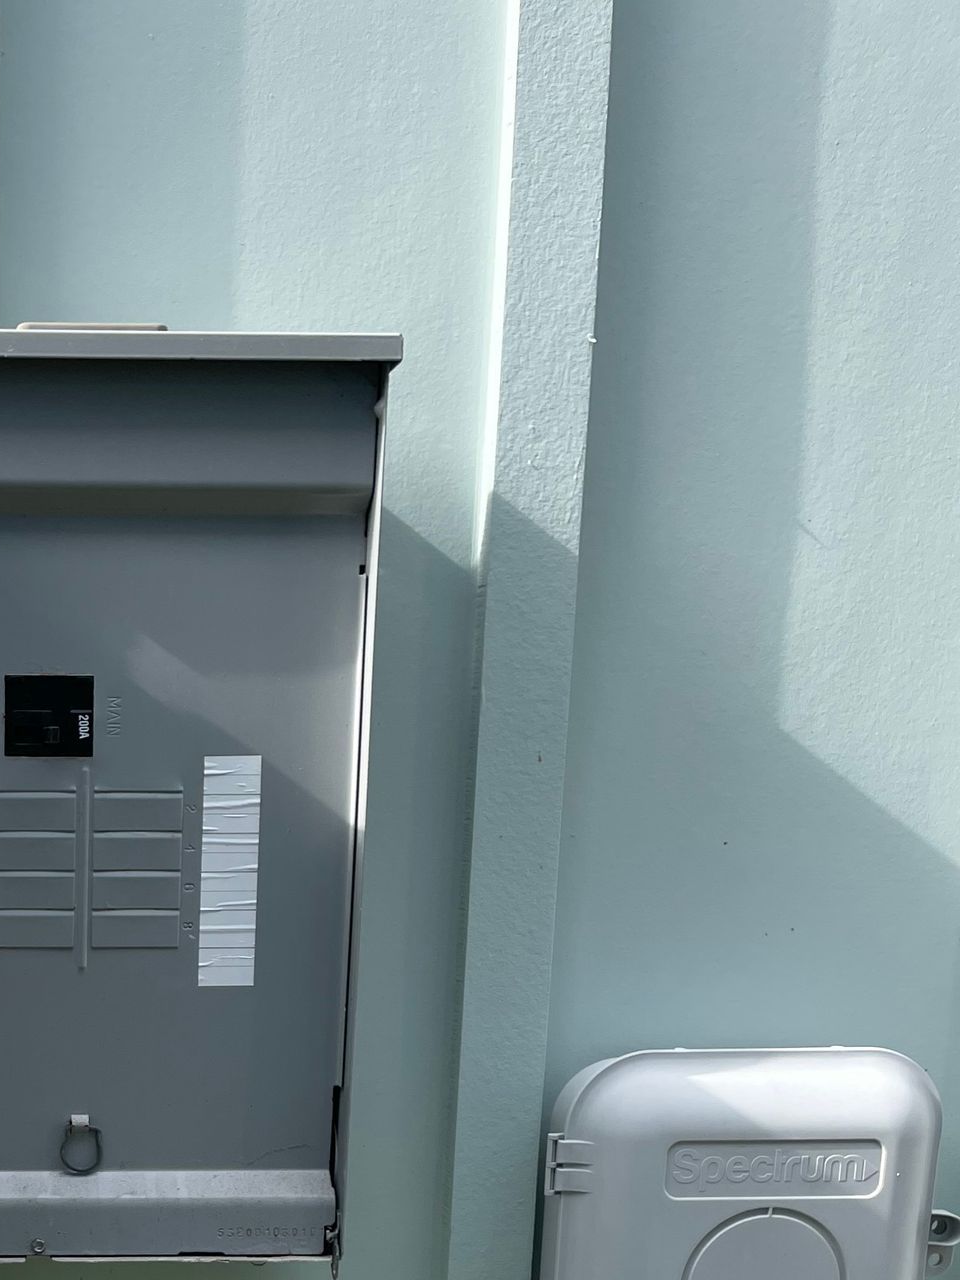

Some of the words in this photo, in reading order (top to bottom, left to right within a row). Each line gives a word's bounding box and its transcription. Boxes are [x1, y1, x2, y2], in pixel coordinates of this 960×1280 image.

[79, 714, 90, 739] 200A
[106, 696, 122, 737] MAIN
[182, 921, 194, 930] 8
[671, 1148, 866, 1192] Spectrum
